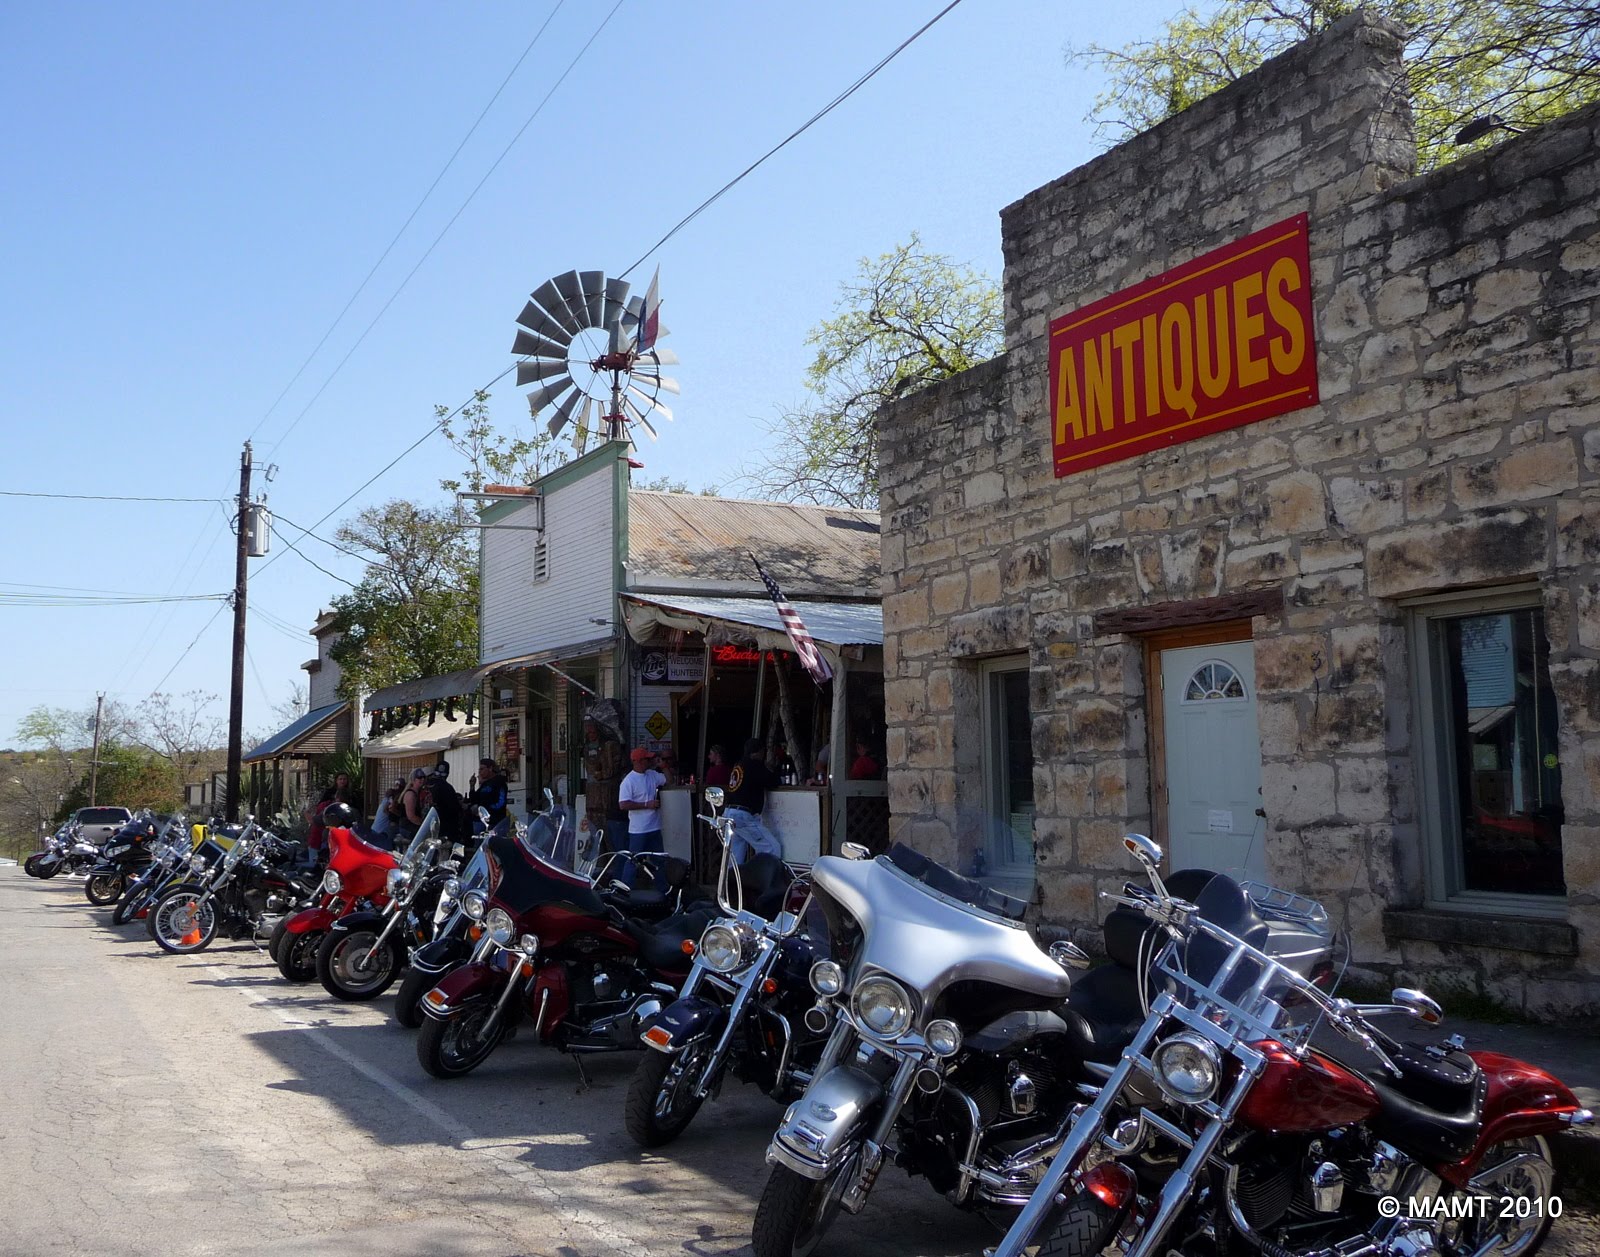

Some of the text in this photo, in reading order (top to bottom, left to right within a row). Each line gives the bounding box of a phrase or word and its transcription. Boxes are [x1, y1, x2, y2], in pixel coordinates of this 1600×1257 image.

[1055, 256, 1306, 446] ANTIQUES
[670, 656, 704, 665] WELCOME
[670, 669, 704, 677] HUNTERS
